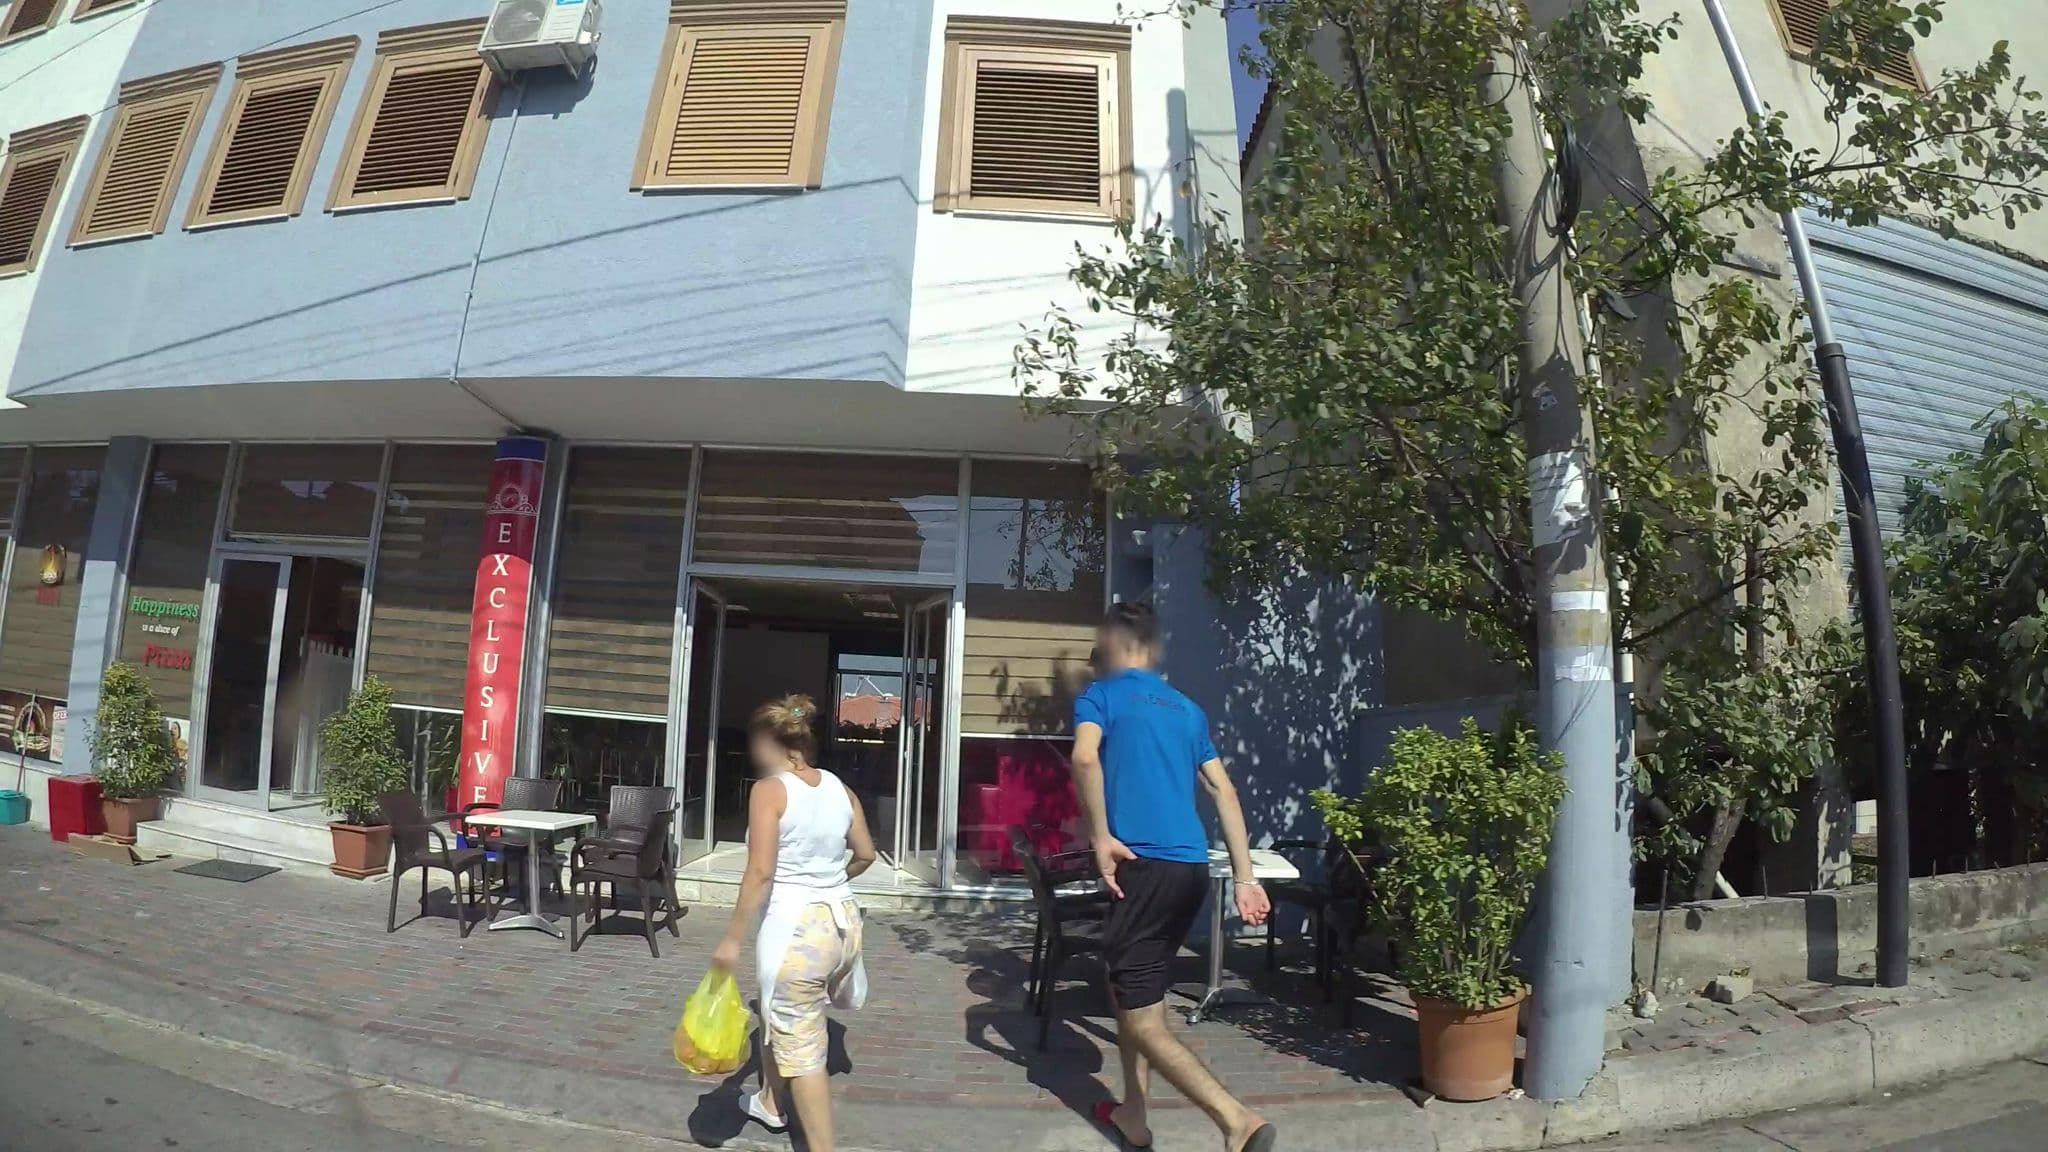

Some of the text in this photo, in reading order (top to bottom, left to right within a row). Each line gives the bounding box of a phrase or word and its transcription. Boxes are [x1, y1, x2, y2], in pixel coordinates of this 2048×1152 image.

[130, 596, 200, 617] Happiness
[171, 626, 180, 636] of
[473, 522, 512, 803] EXCLUSIVE
